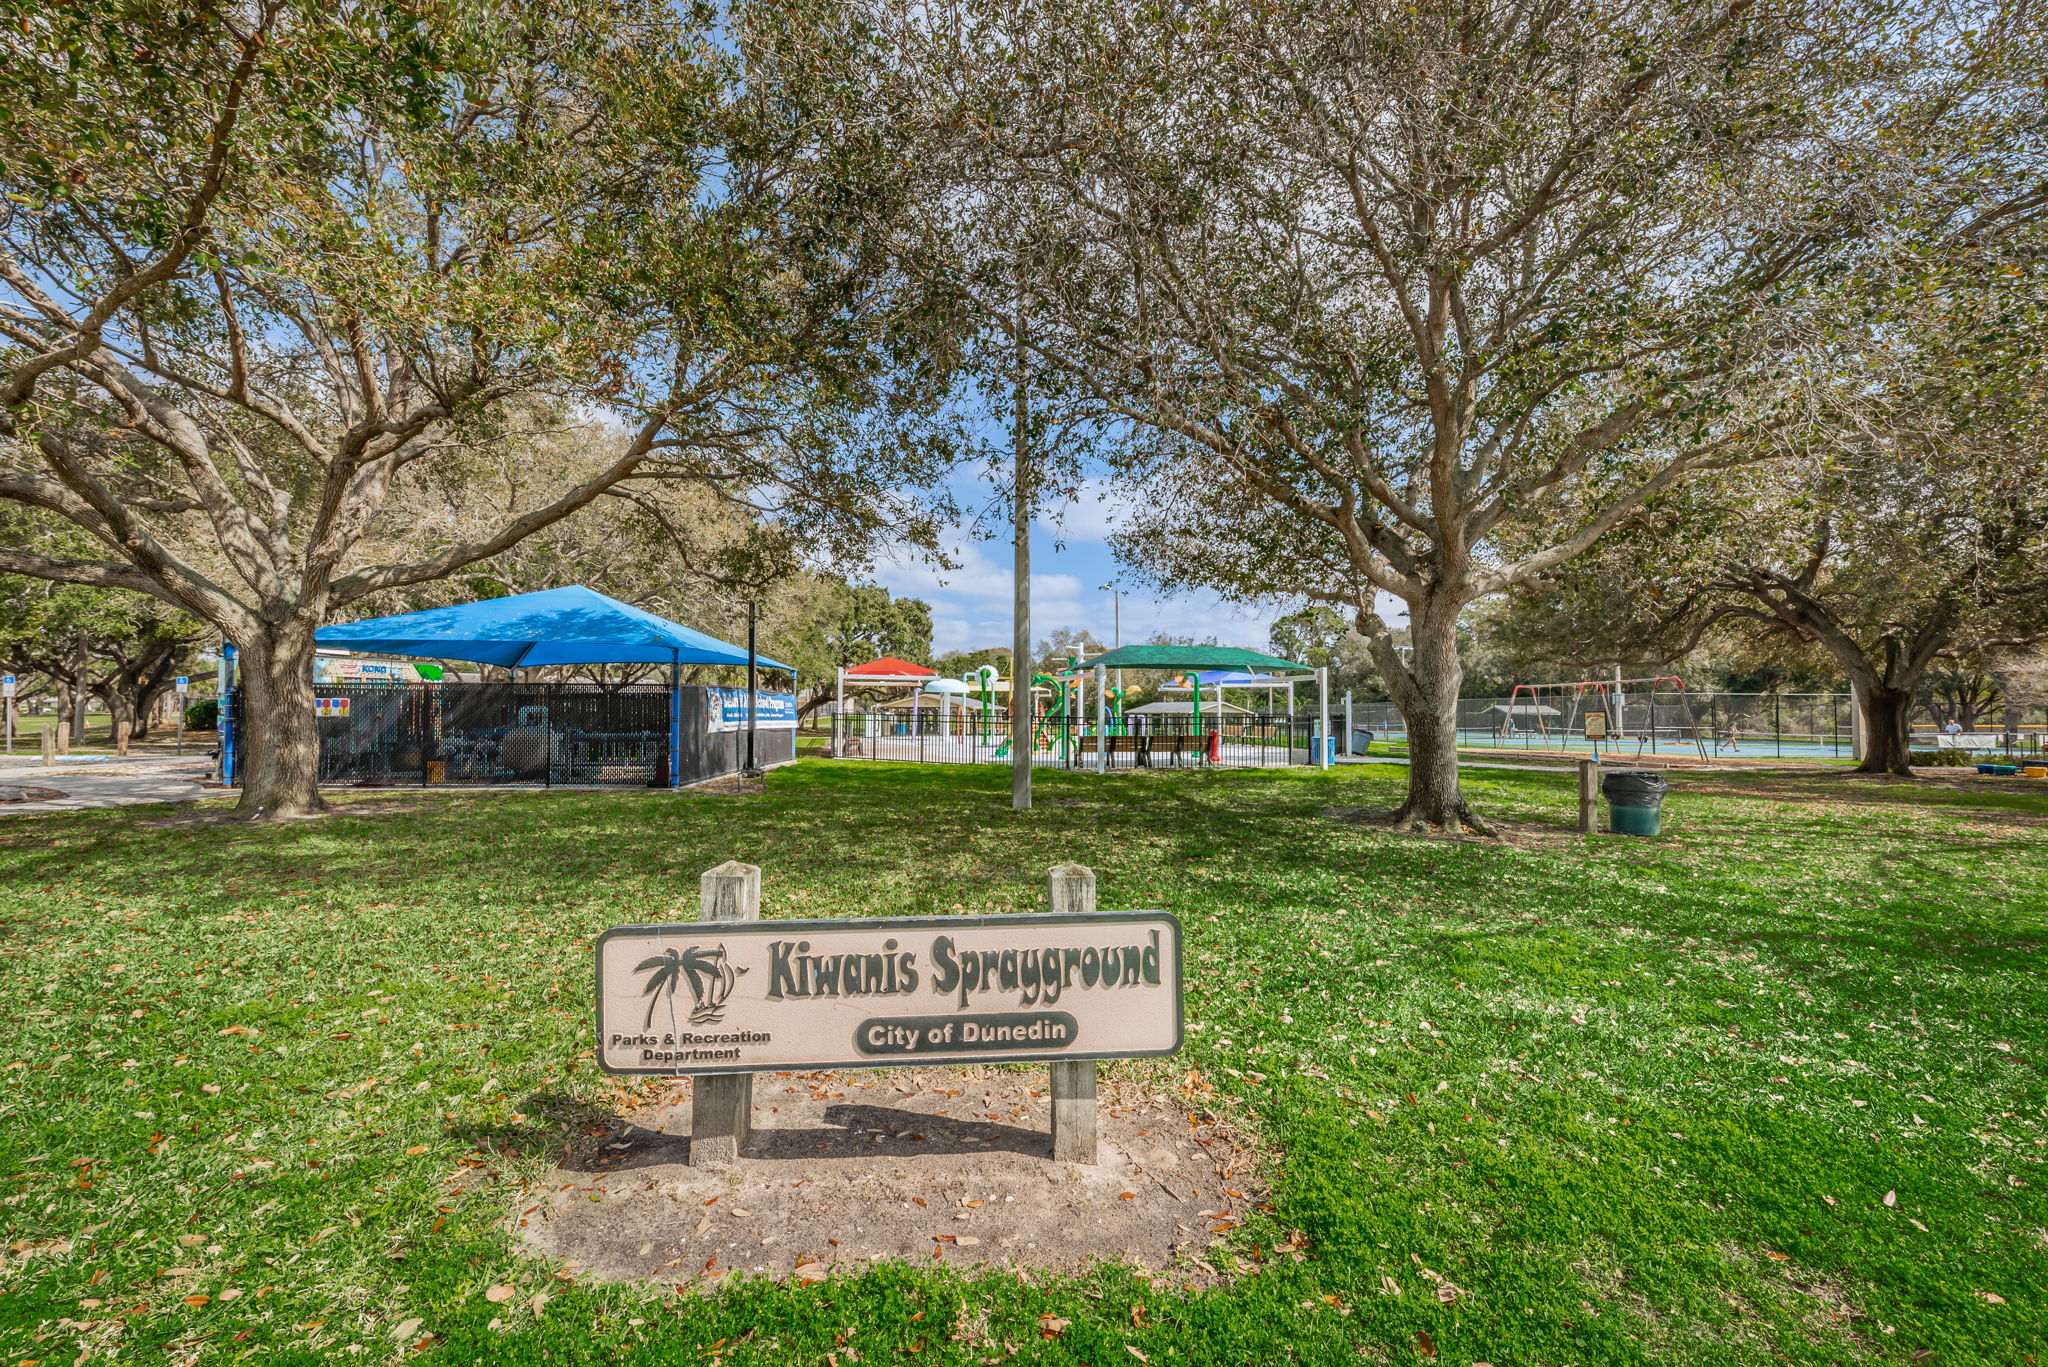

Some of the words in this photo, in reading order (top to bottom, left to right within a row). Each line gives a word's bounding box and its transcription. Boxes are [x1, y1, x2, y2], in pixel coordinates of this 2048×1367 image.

[768, 938, 919, 999] Kiwanis
[932, 929, 1162, 1011] Sprayground
[611, 1033, 658, 1046] Parks
[663, 1033, 675, 1045] &
[682, 1030, 772, 1045] Recreation
[868, 1025, 919, 1050] City
[928, 1023, 954, 1044] of
[963, 1020, 1067, 1042] Dunedin
[643, 1046, 741, 1064] Department
